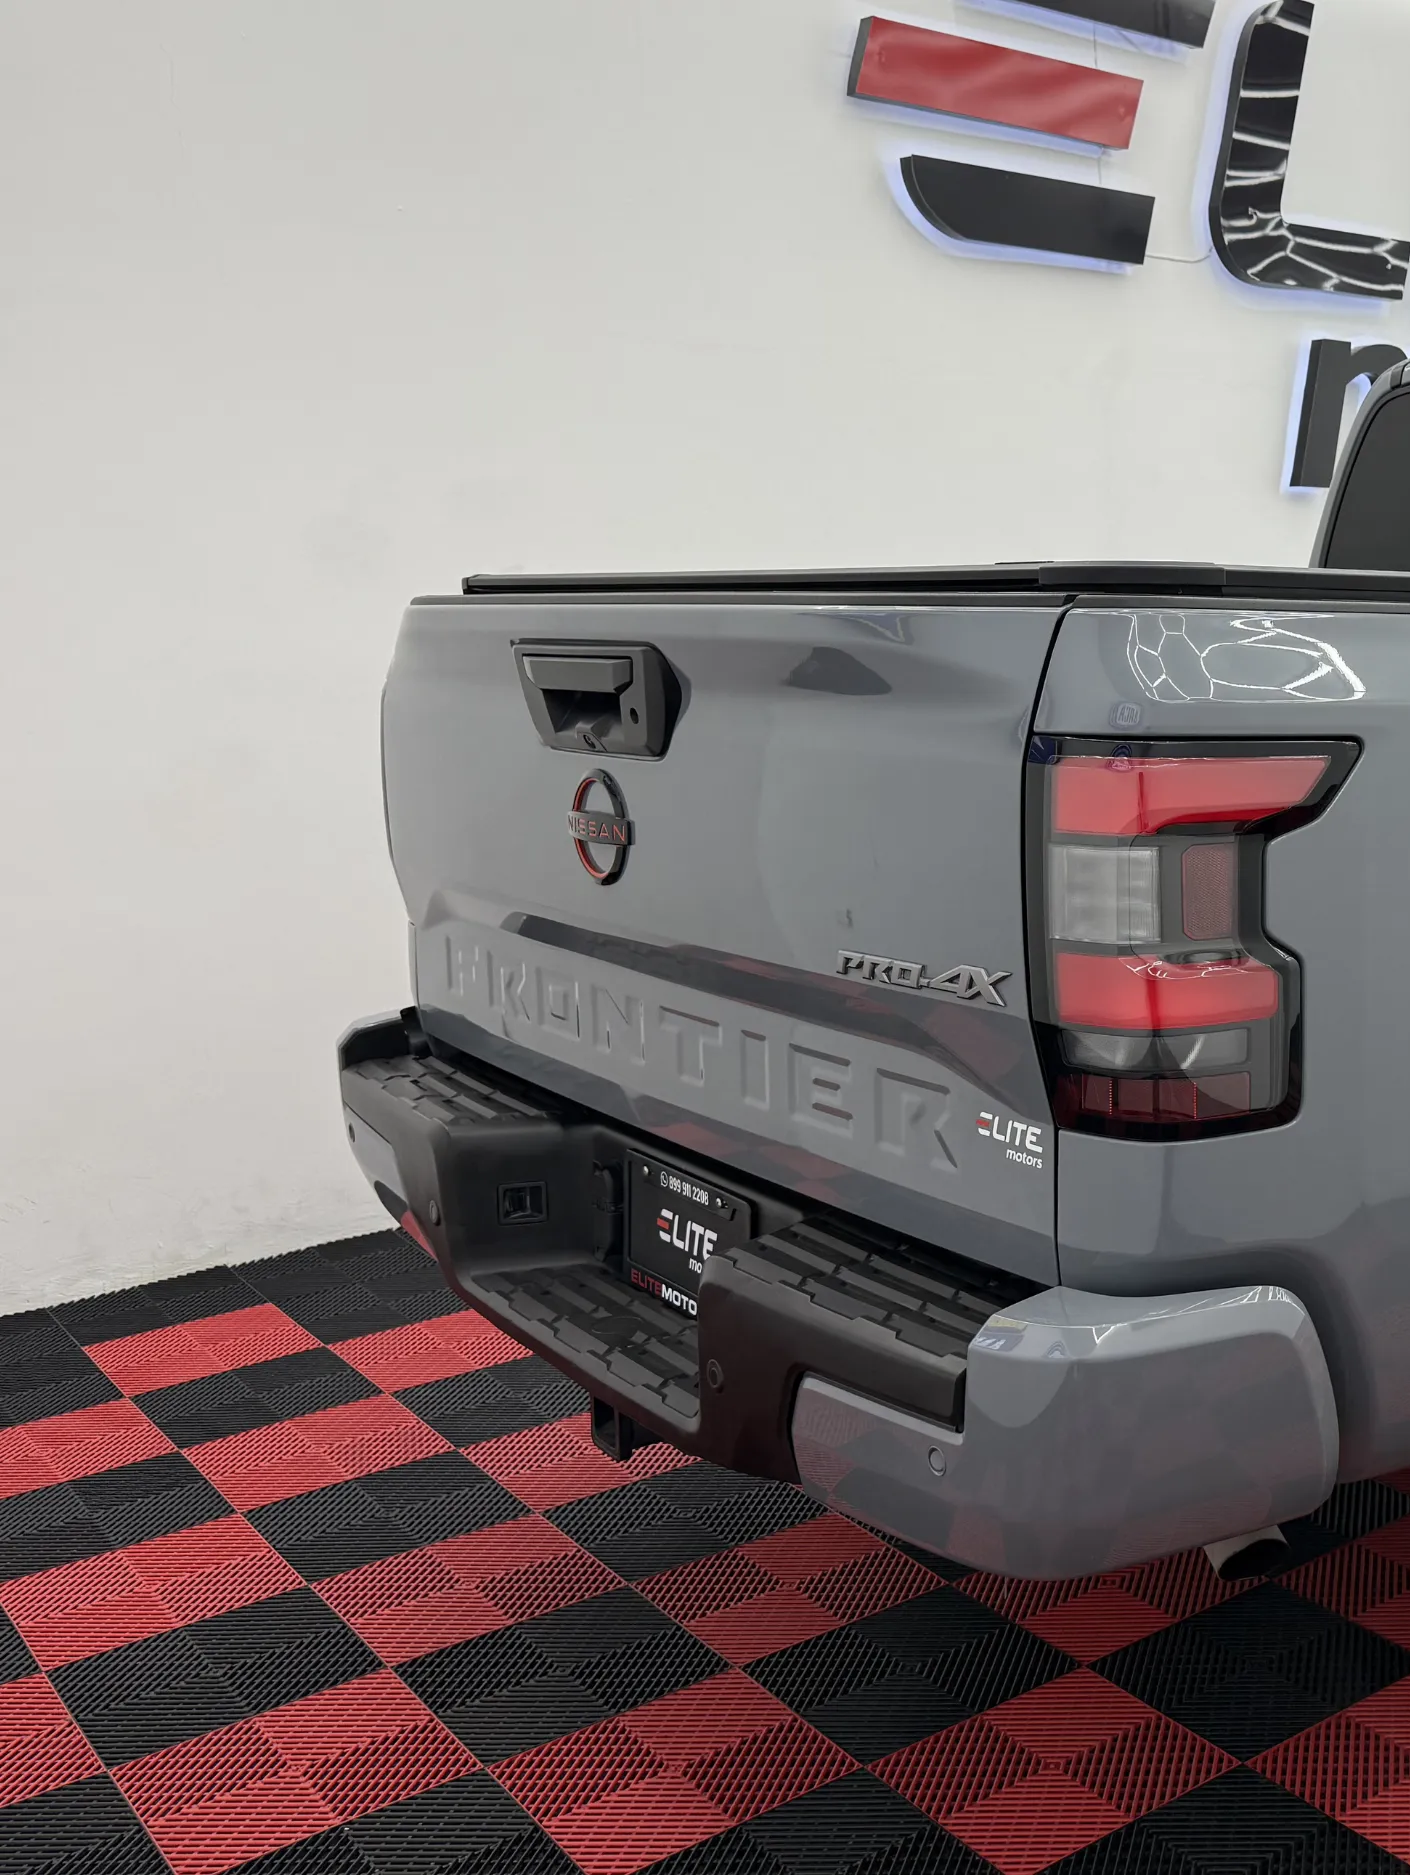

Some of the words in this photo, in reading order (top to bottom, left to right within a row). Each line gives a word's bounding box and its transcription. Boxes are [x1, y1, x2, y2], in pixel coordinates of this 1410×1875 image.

[567, 814, 626, 842] NISSAN
[836, 948, 1013, 1008] PRO-4X
[443, 934, 960, 1171] FRONTIER
[975, 1110, 1044, 1154] ELITE
[1005, 1147, 1044, 1170] motors
[669, 1174, 681, 1194] 899
[682, 1180, 692, 1199] 911
[692, 1186, 709, 1206] 2208
[656, 1208, 718, 1261] ELITE
[630, 1267, 698, 1316] ELITEMOTO
